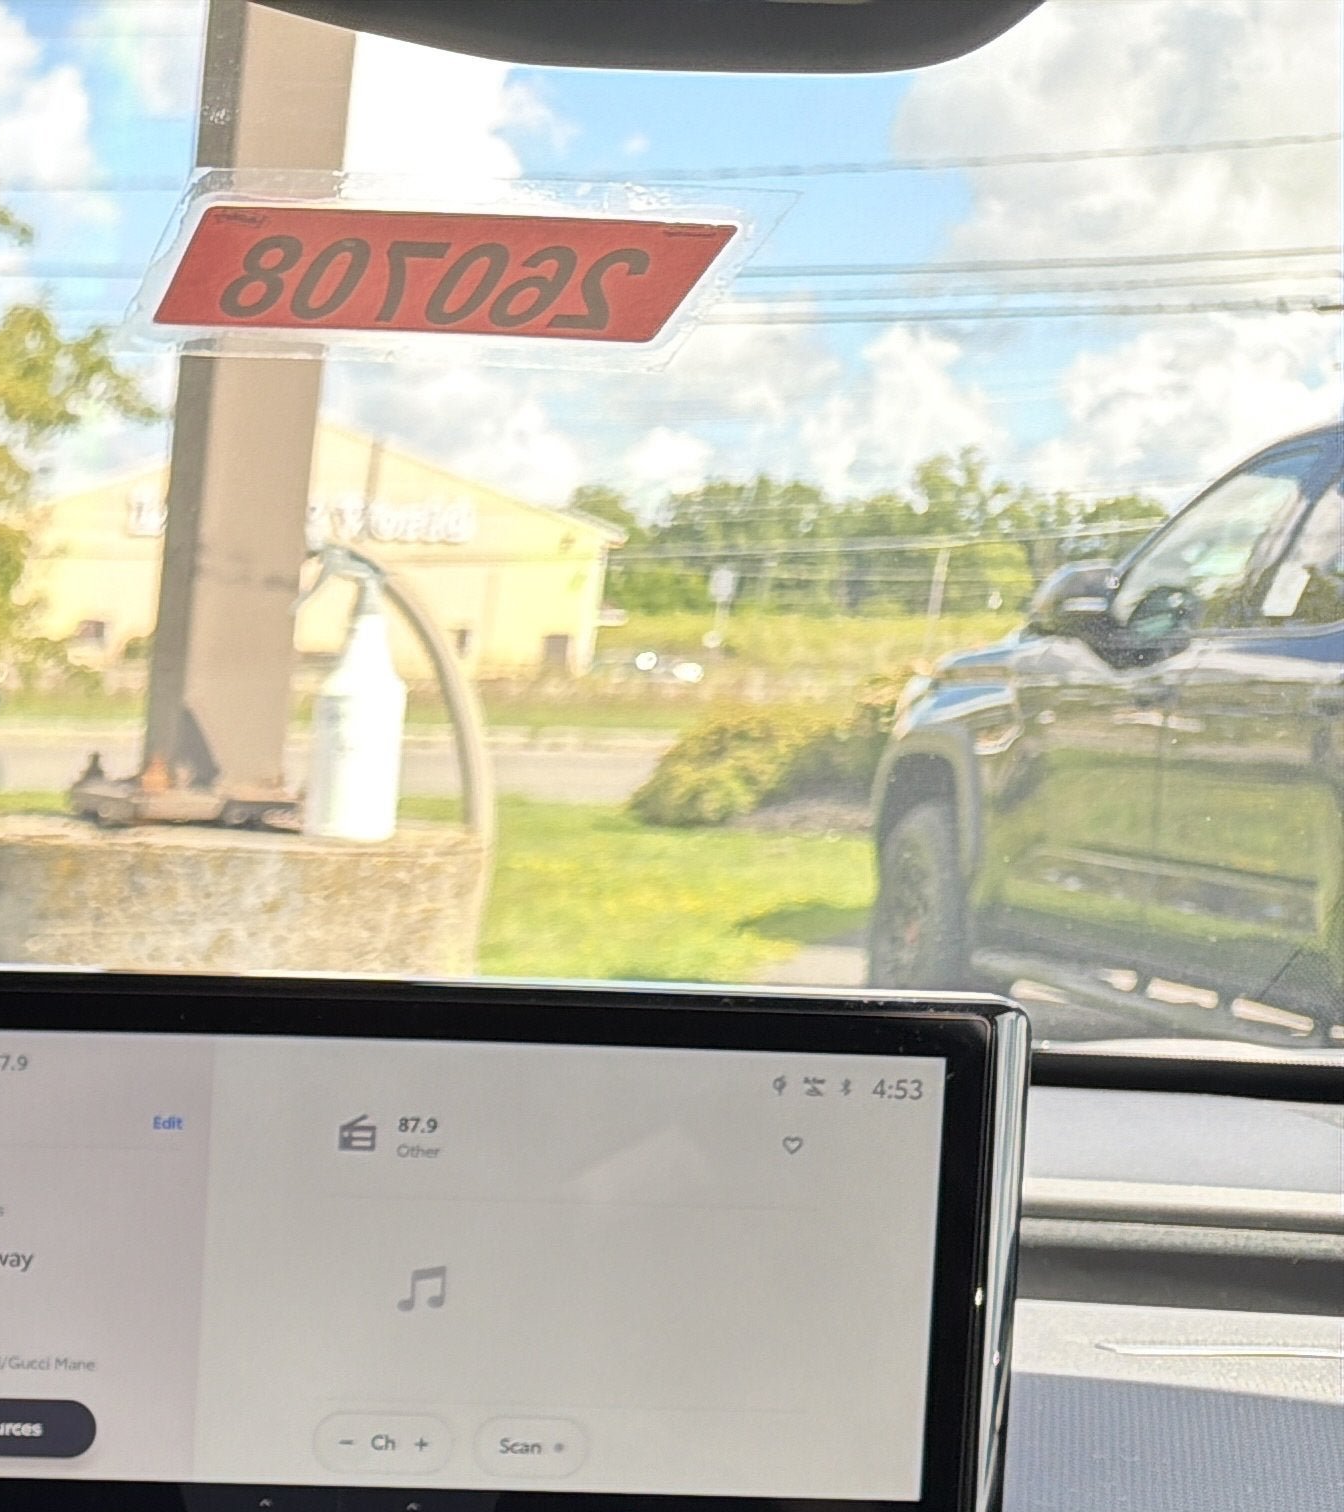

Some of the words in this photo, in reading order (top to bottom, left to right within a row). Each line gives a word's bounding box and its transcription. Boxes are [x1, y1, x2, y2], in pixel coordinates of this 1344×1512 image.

[871, 1078, 924, 1102] 4:53
[152, 1115, 184, 1131] Edit
[397, 1116, 439, 1135] 87.9
[396, 1143, 442, 1160] Other
[54, 1357, 96, 1372] Mane
[370, 1433, 397, 1453] Ch
[498, 1437, 543, 1457] Scan
